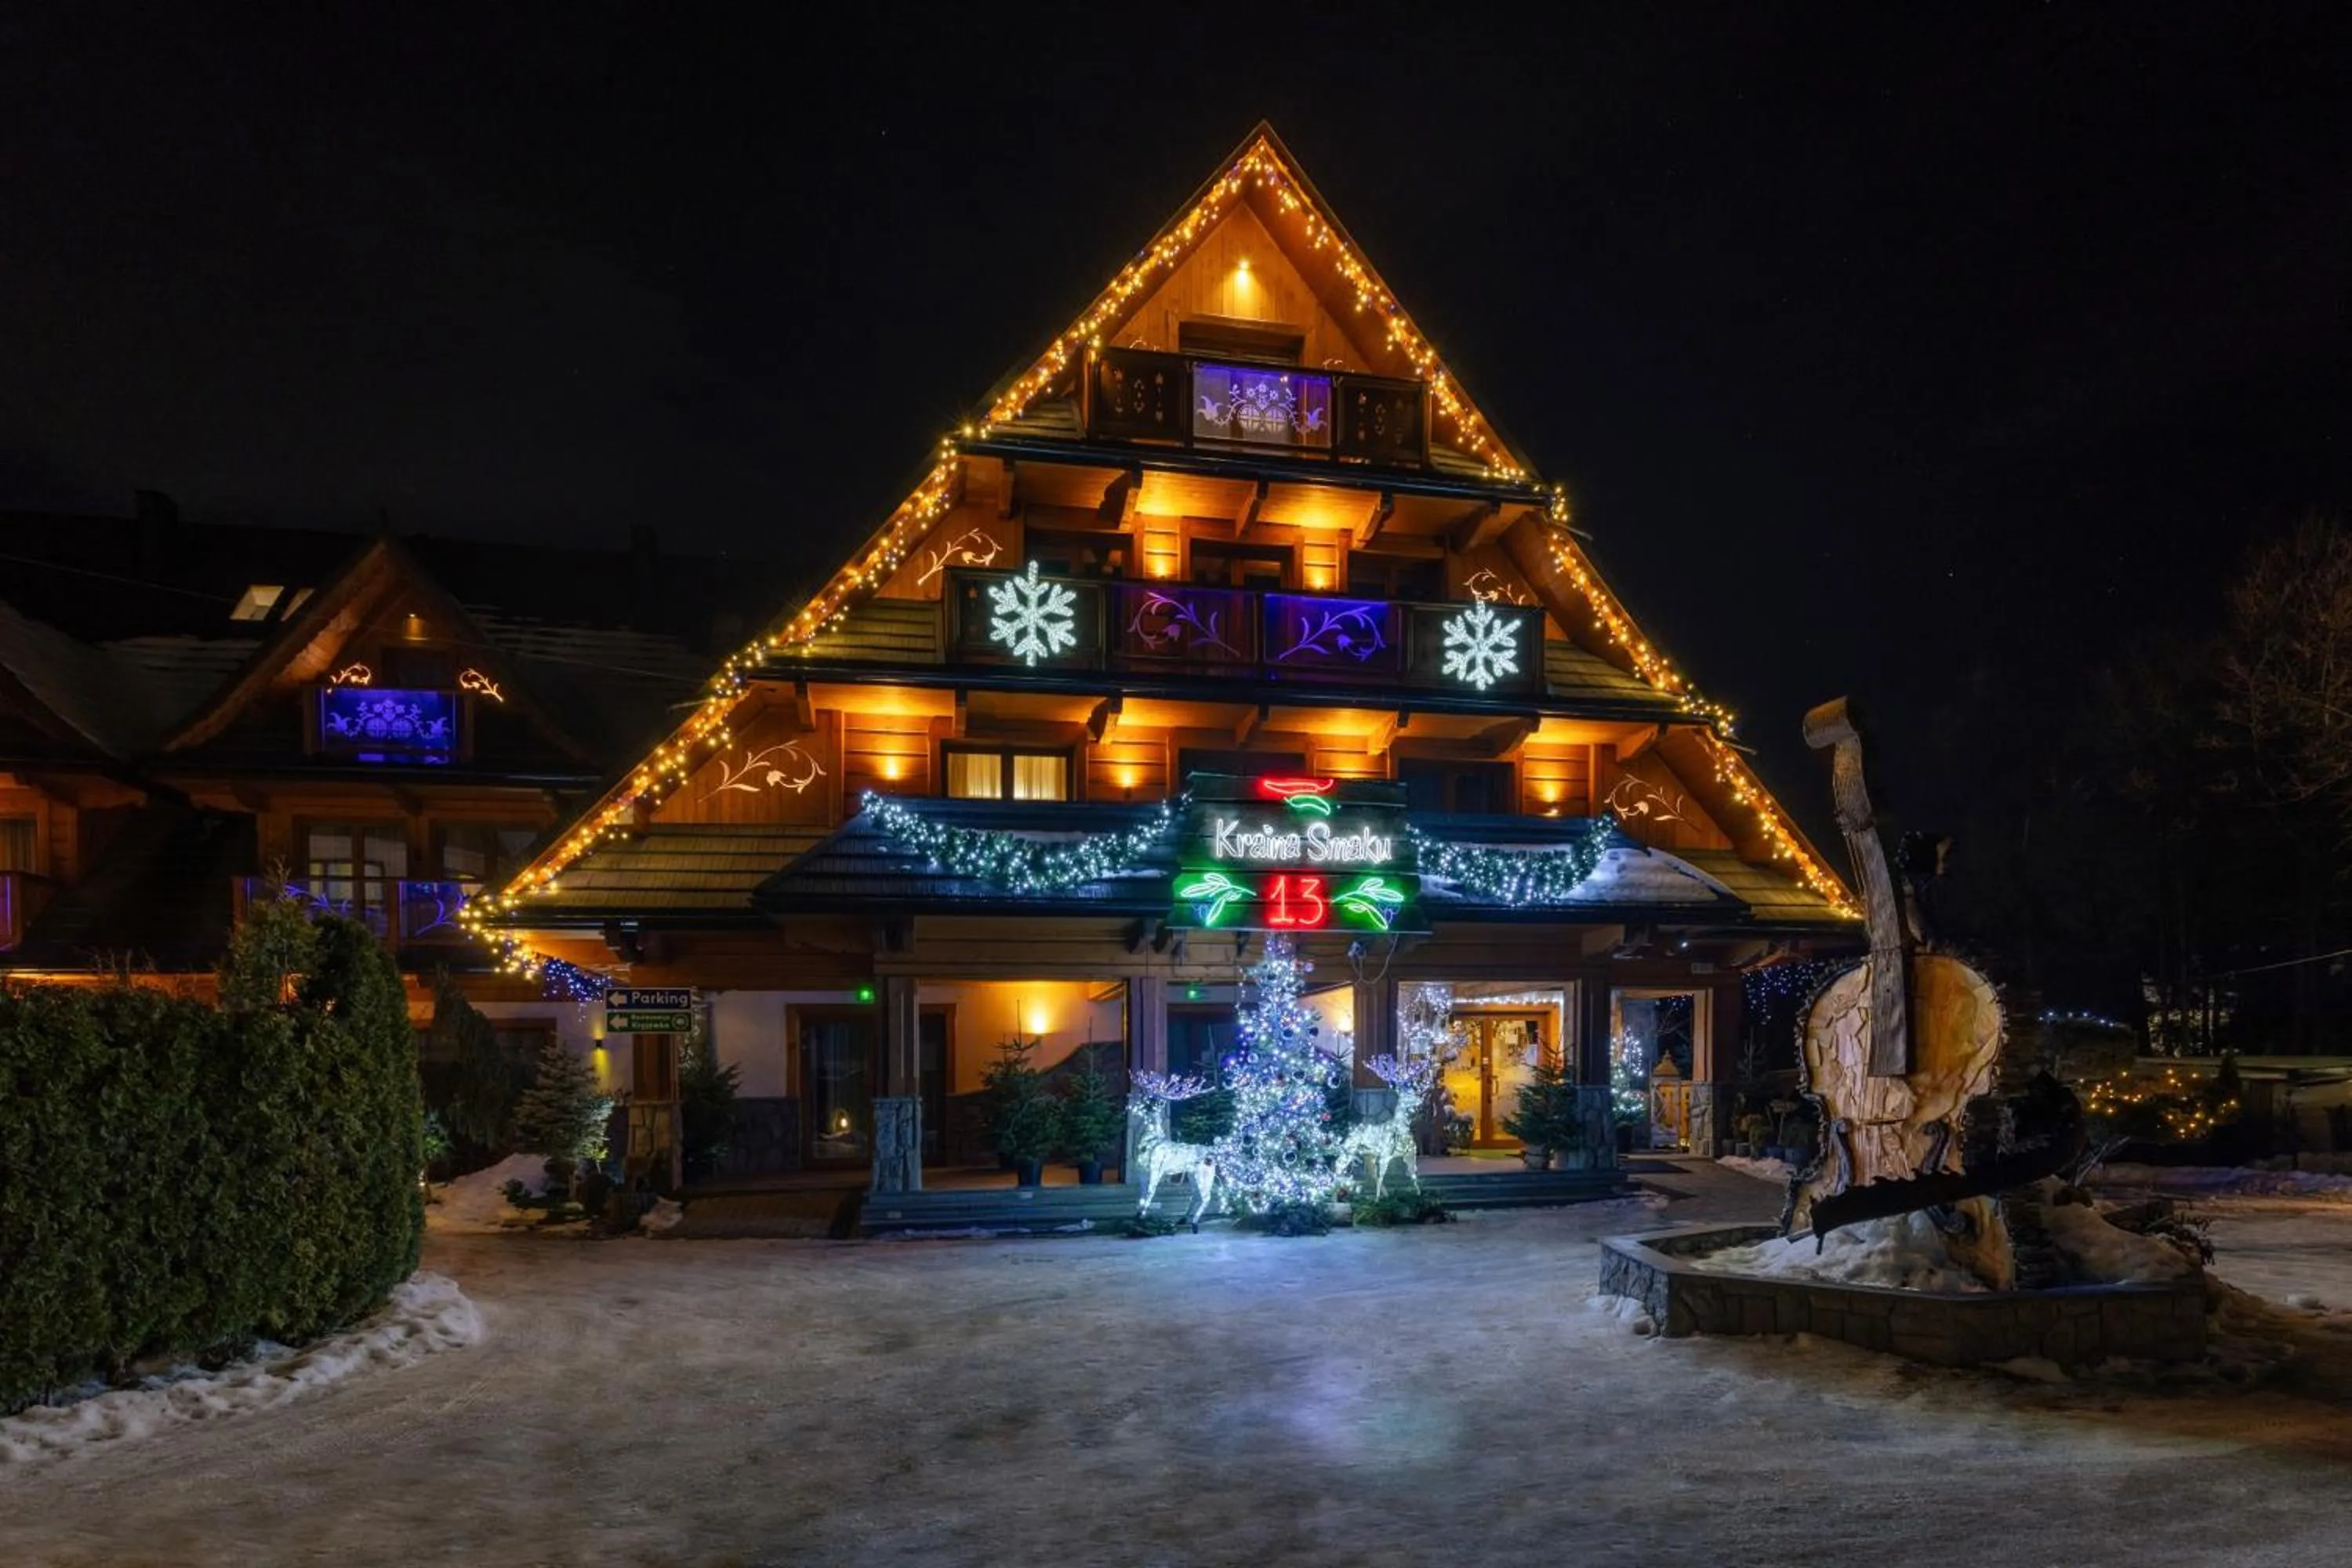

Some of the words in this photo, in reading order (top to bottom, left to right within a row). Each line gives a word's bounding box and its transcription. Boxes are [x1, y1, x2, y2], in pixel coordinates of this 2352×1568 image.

[1214, 818, 1301, 860] Kraina
[1306, 822, 1392, 863] Smaku
[1269, 874, 1324, 925] 13
[631, 991, 688, 1008] Parking
